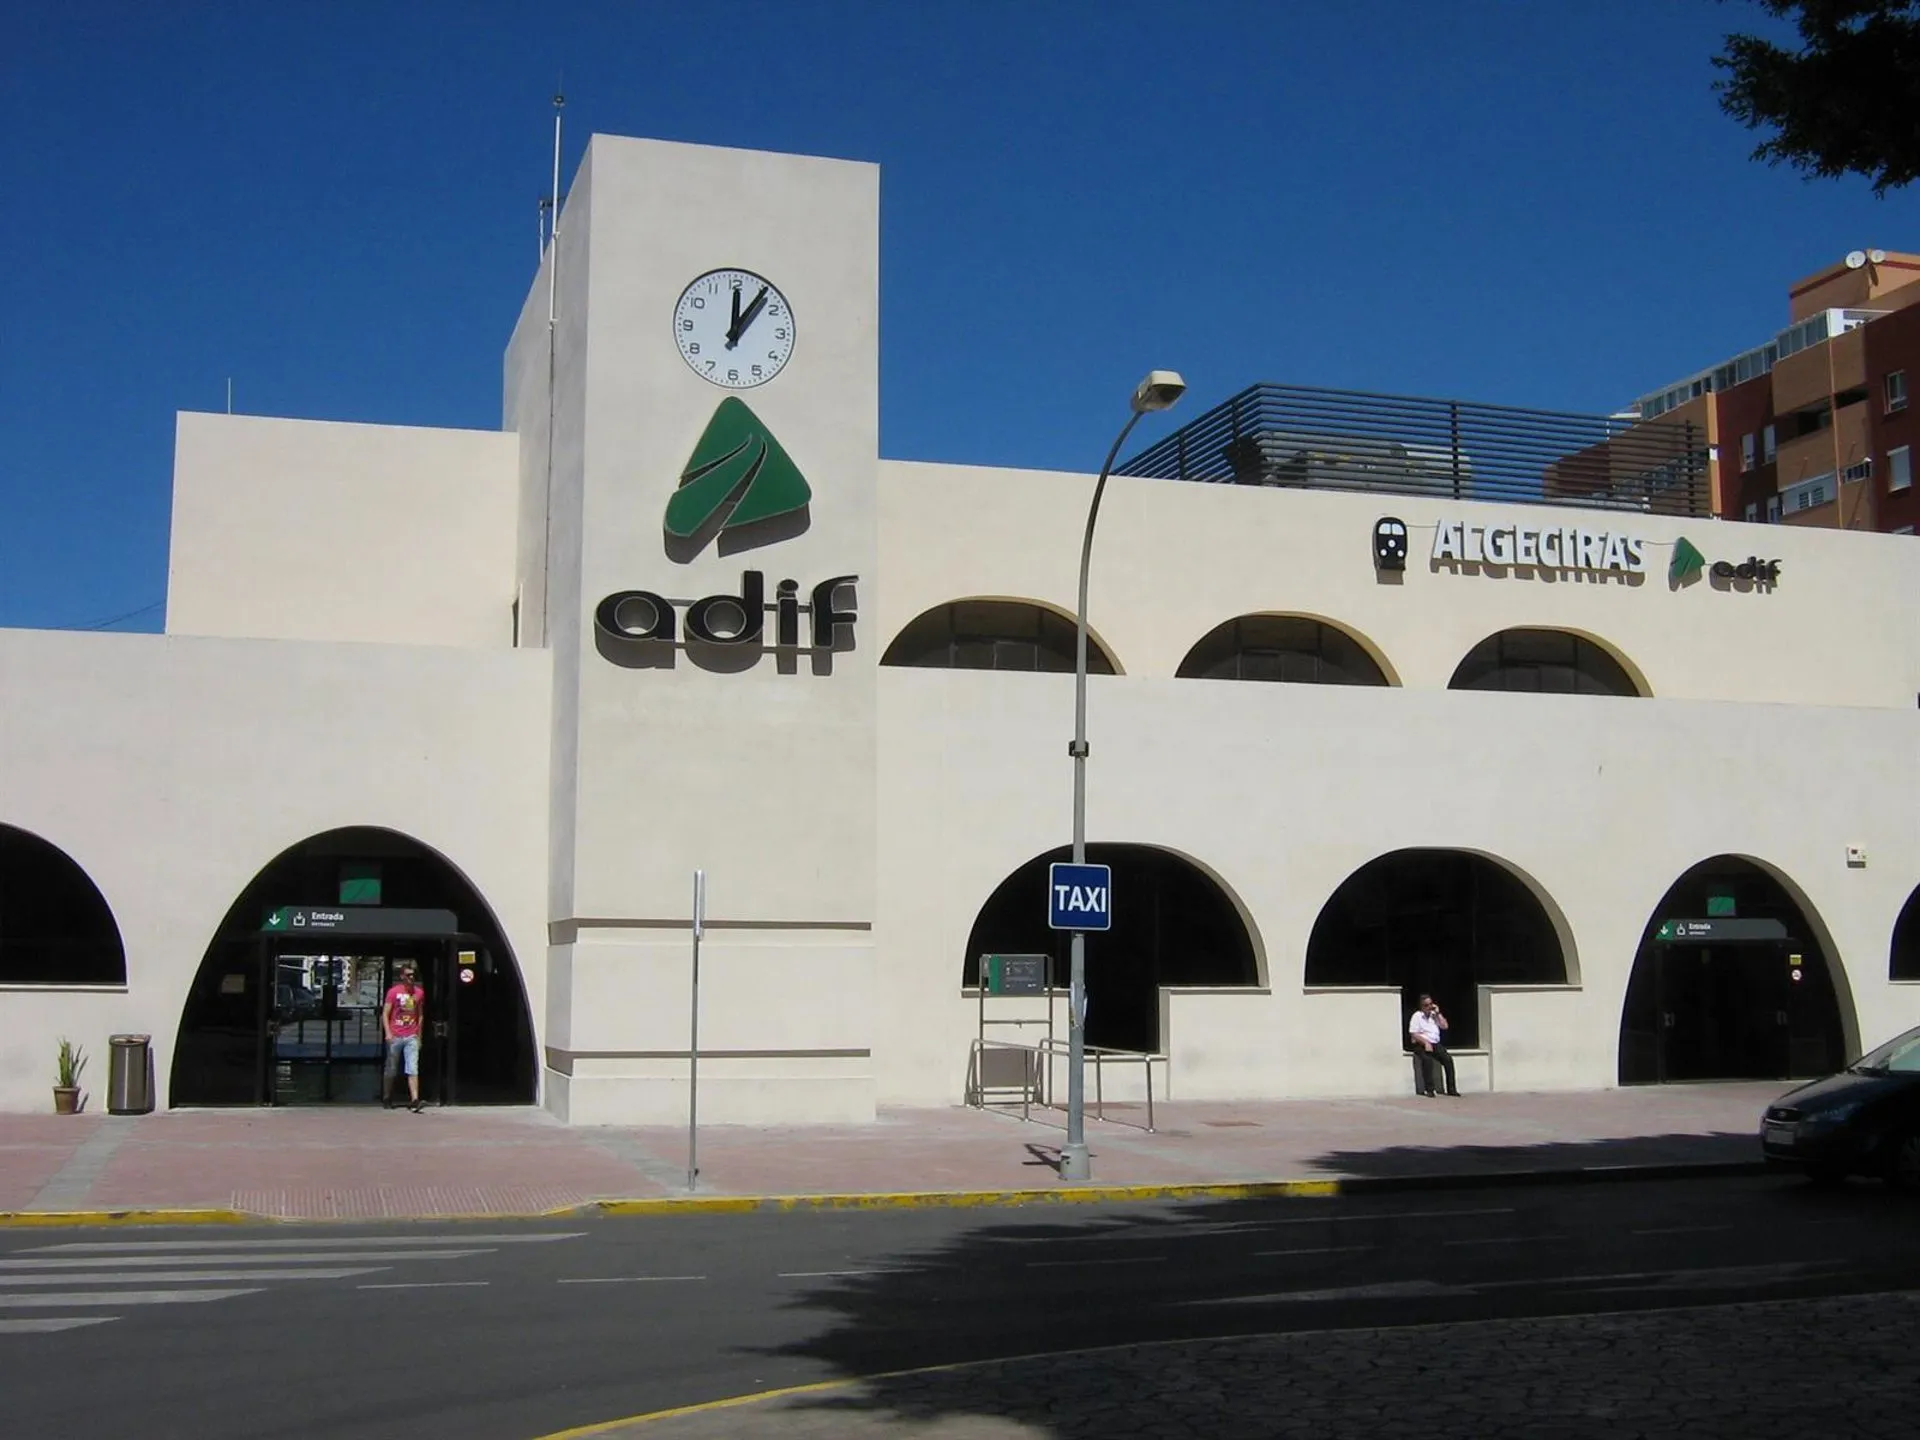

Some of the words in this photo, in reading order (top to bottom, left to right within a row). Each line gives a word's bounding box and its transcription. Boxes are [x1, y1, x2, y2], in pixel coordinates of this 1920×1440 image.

[708, 283, 718, 294] 11
[729, 279, 743, 291] 12
[690, 297, 705, 309] 10
[768, 304, 779, 316] 2
[682, 319, 693, 331] 9
[775, 328, 786, 340] 3
[689, 342, 700, 355] 8
[705, 360, 716, 371] 7
[751, 364, 762, 376] 5
[727, 369, 739, 381] 6
[1434, 518, 1644, 573] ALGECIRAS
[1711, 555, 1783, 581] adif
[594, 570, 859, 648] adif
[1054, 884, 1107, 914] TAXI
[311, 912, 344, 921] Entrada
